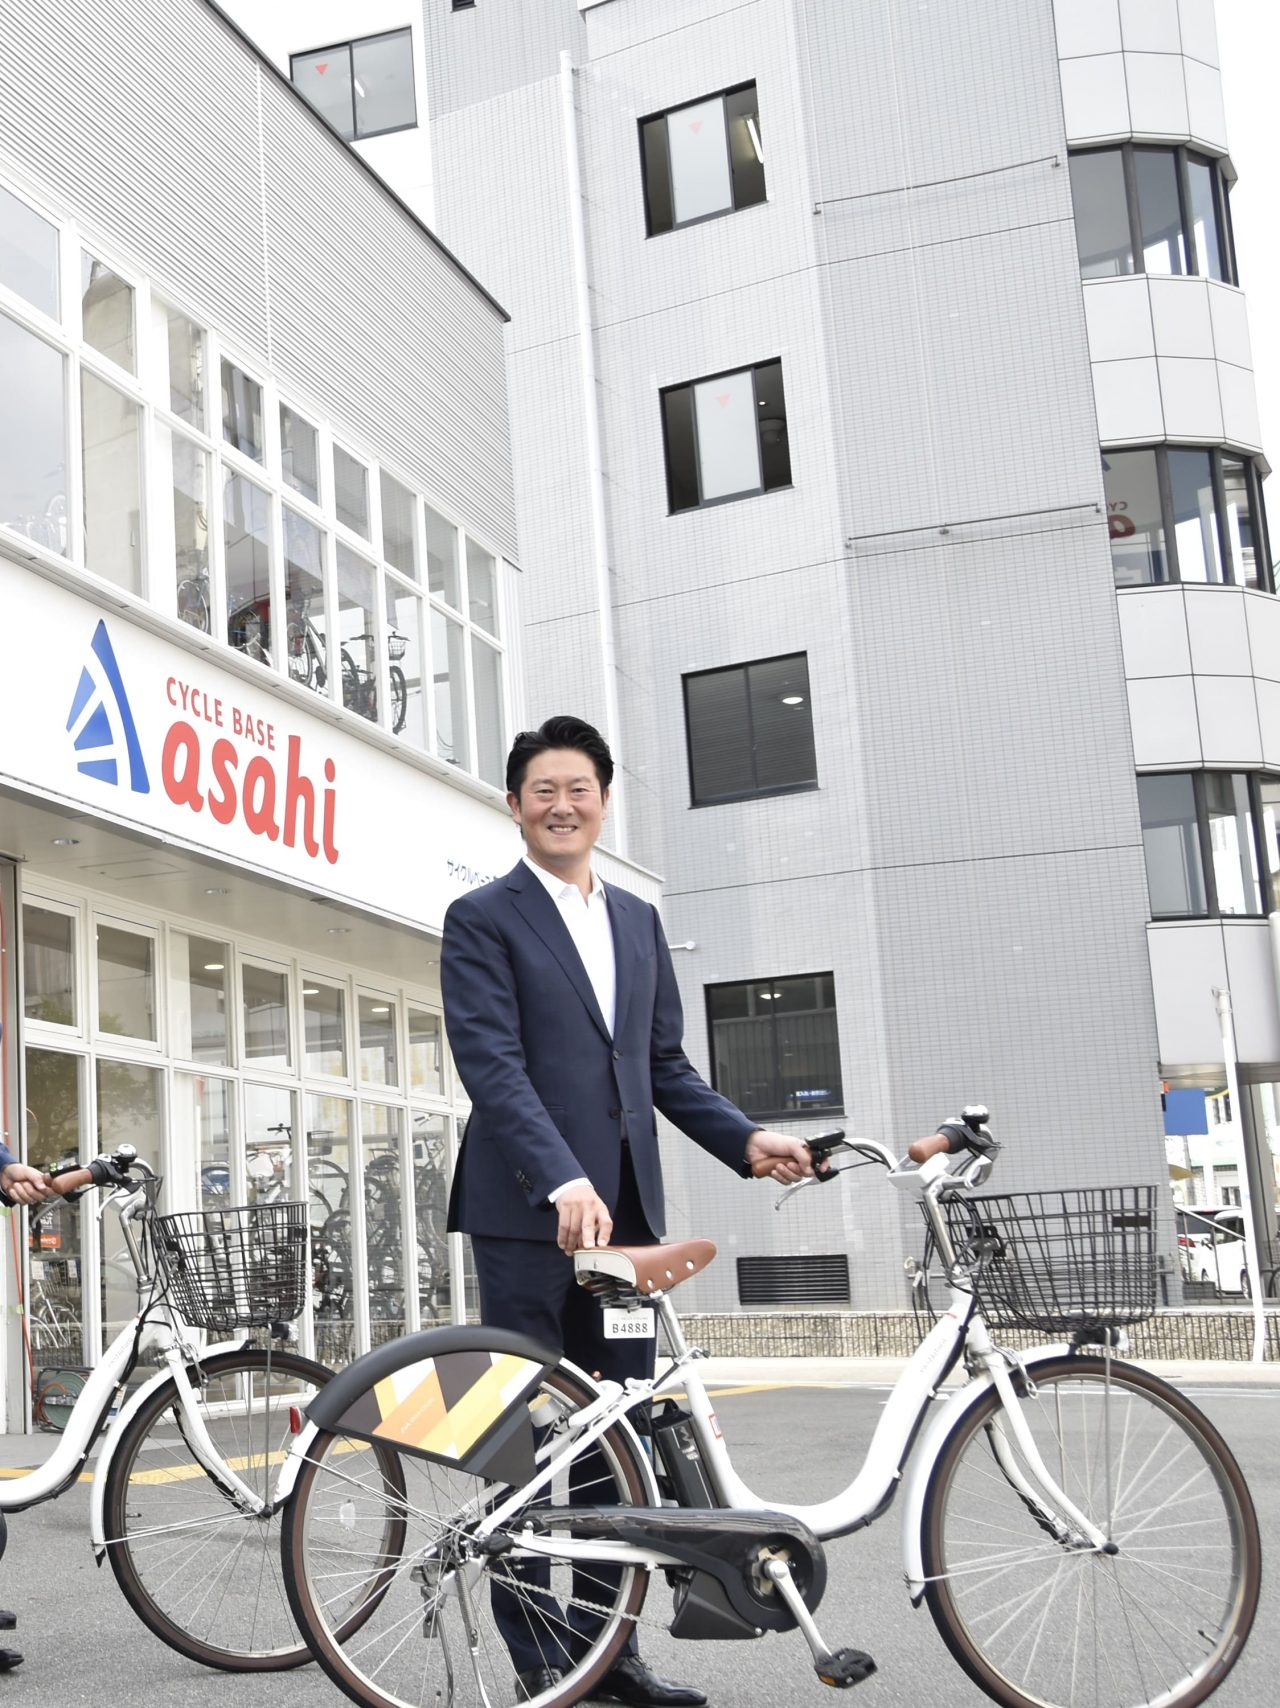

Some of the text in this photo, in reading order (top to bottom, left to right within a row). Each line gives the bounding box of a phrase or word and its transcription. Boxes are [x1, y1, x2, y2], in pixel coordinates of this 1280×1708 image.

[166, 676, 276, 751] CYCLE BASE
[161, 720, 339, 865] asahi
[612, 1322, 648, 1334] B4888
